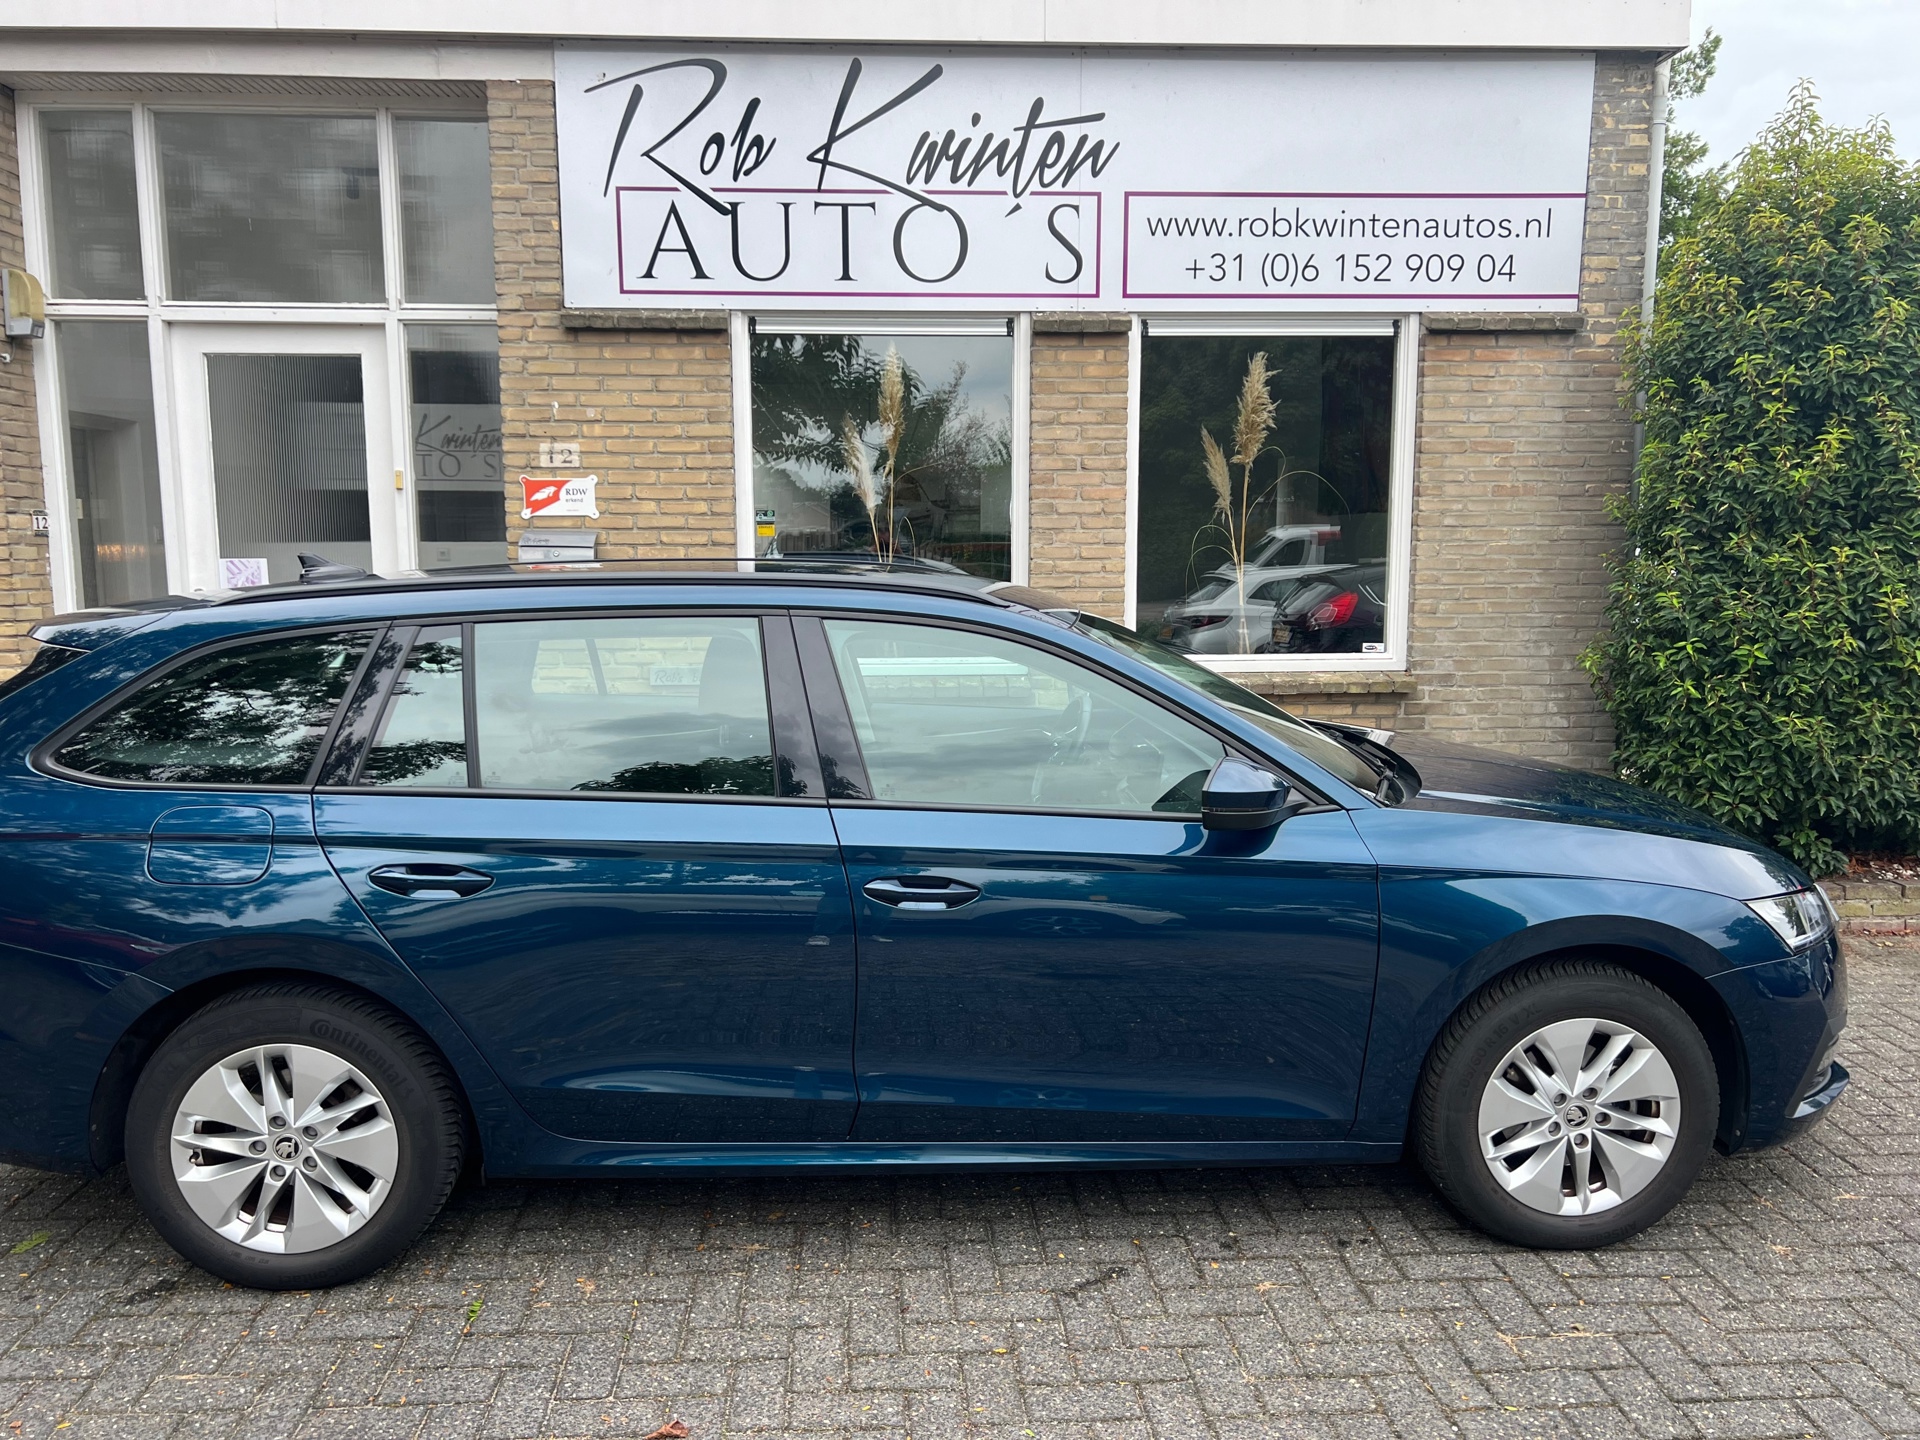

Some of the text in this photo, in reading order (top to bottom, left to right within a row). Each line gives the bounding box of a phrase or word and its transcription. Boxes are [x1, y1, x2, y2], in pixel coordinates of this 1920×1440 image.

[584, 57, 1120, 216] Rob Kwinten
[1146, 207, 1553, 239] www.robkwintenautos.nl
[1185, 252, 1517, 287] +31 (0)6 152 909 04
[565, 488, 588, 496] RDW
[35, 516, 49, 529] 12
[308, 1018, 405, 1089] Continental
